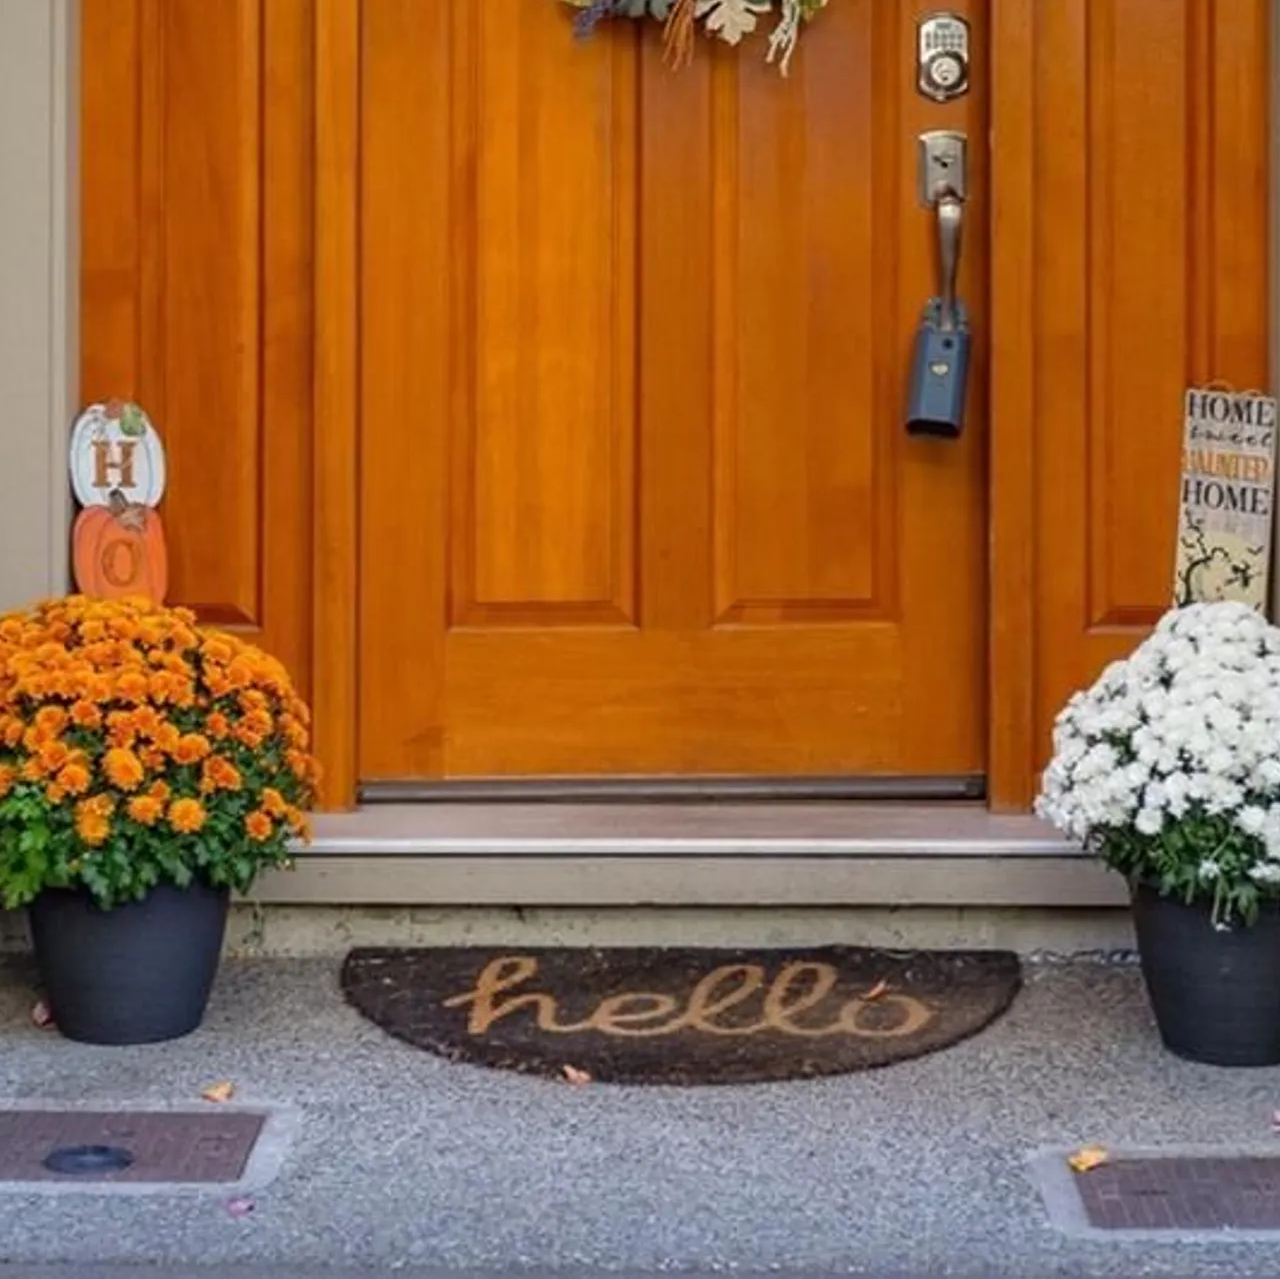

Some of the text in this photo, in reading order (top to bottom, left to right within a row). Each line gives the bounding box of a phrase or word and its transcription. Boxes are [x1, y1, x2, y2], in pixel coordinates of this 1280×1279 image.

[1188, 391, 1275, 427] HOME
[1183, 477, 1269, 516] HOME
[442, 956, 937, 1038] hello
